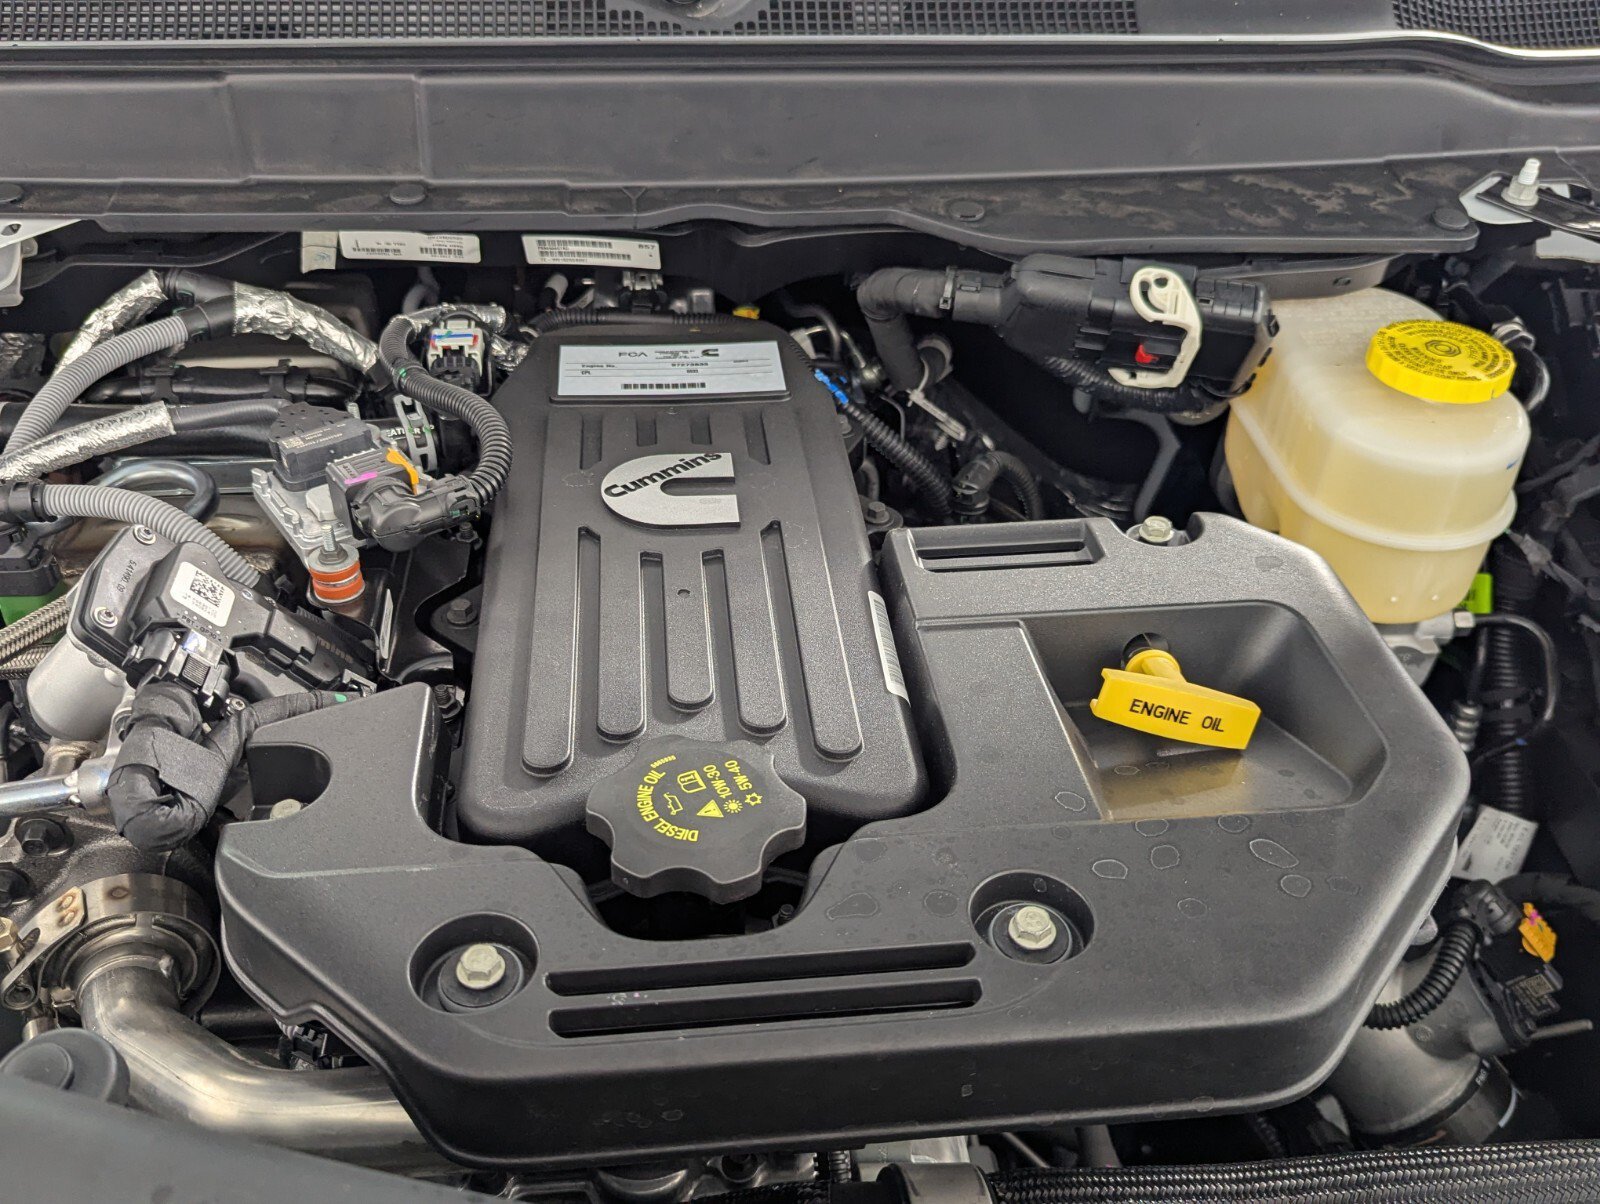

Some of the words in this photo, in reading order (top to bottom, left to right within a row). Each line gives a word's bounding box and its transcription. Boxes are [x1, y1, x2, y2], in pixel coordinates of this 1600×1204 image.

[603, 452, 722, 498] Cummins
[1129, 698, 1192, 725] ENGINE
[1201, 715, 1224, 732] OIL
[643, 769, 666, 785] OIL
[703, 764, 732, 799] 10W-30
[724, 760, 752, 791] 5W-40
[636, 784, 660, 822] ENGINE
[653, 818, 699, 842] DIESEL
